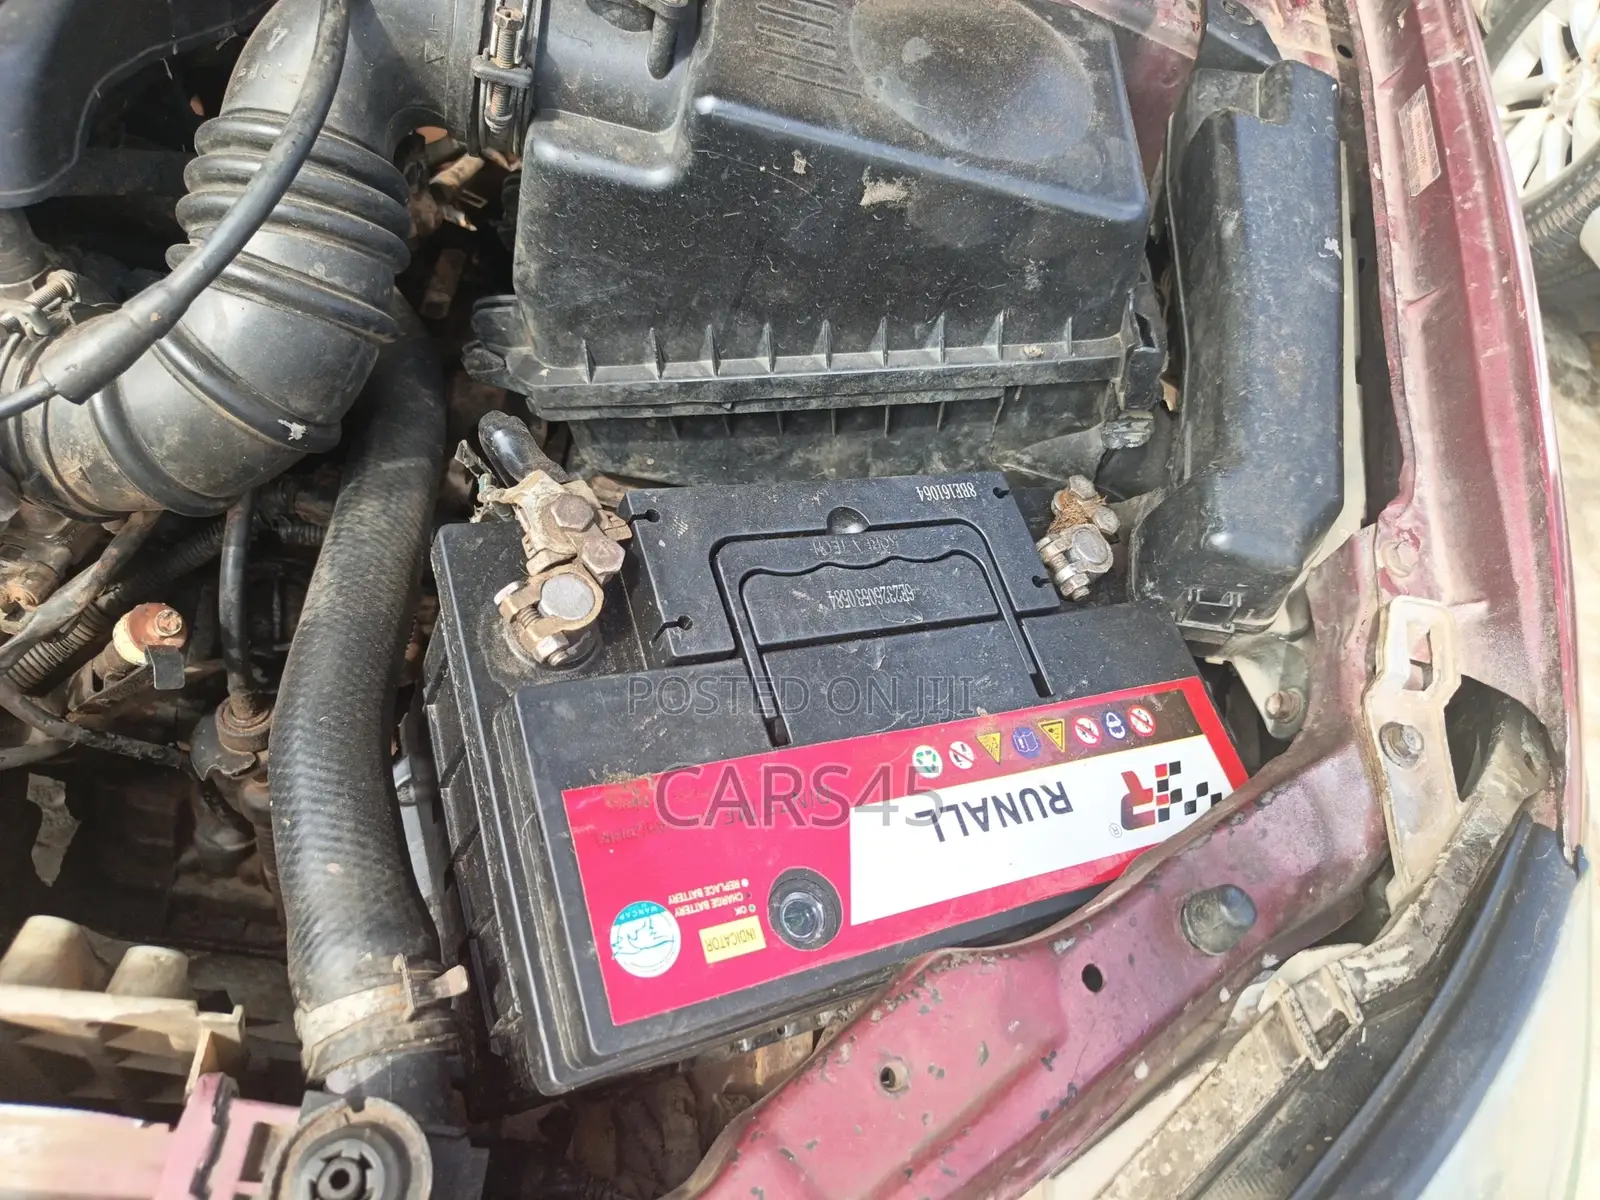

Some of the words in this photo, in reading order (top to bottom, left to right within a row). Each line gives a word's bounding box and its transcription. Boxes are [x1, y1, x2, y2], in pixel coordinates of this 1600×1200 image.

[915, 481, 977, 502] 8BE161064
[826, 582, 916, 609] 6E23260530584
[913, 780, 1074, 844] RUNALL
[667, 886, 704, 905] BATTERY
[703, 879, 741, 897] REPLACE
[674, 900, 710, 917] BATTERY
[709, 892, 744, 911] CHARGE
[733, 905, 748, 916] OK
[703, 926, 757, 952] INDICATOR
